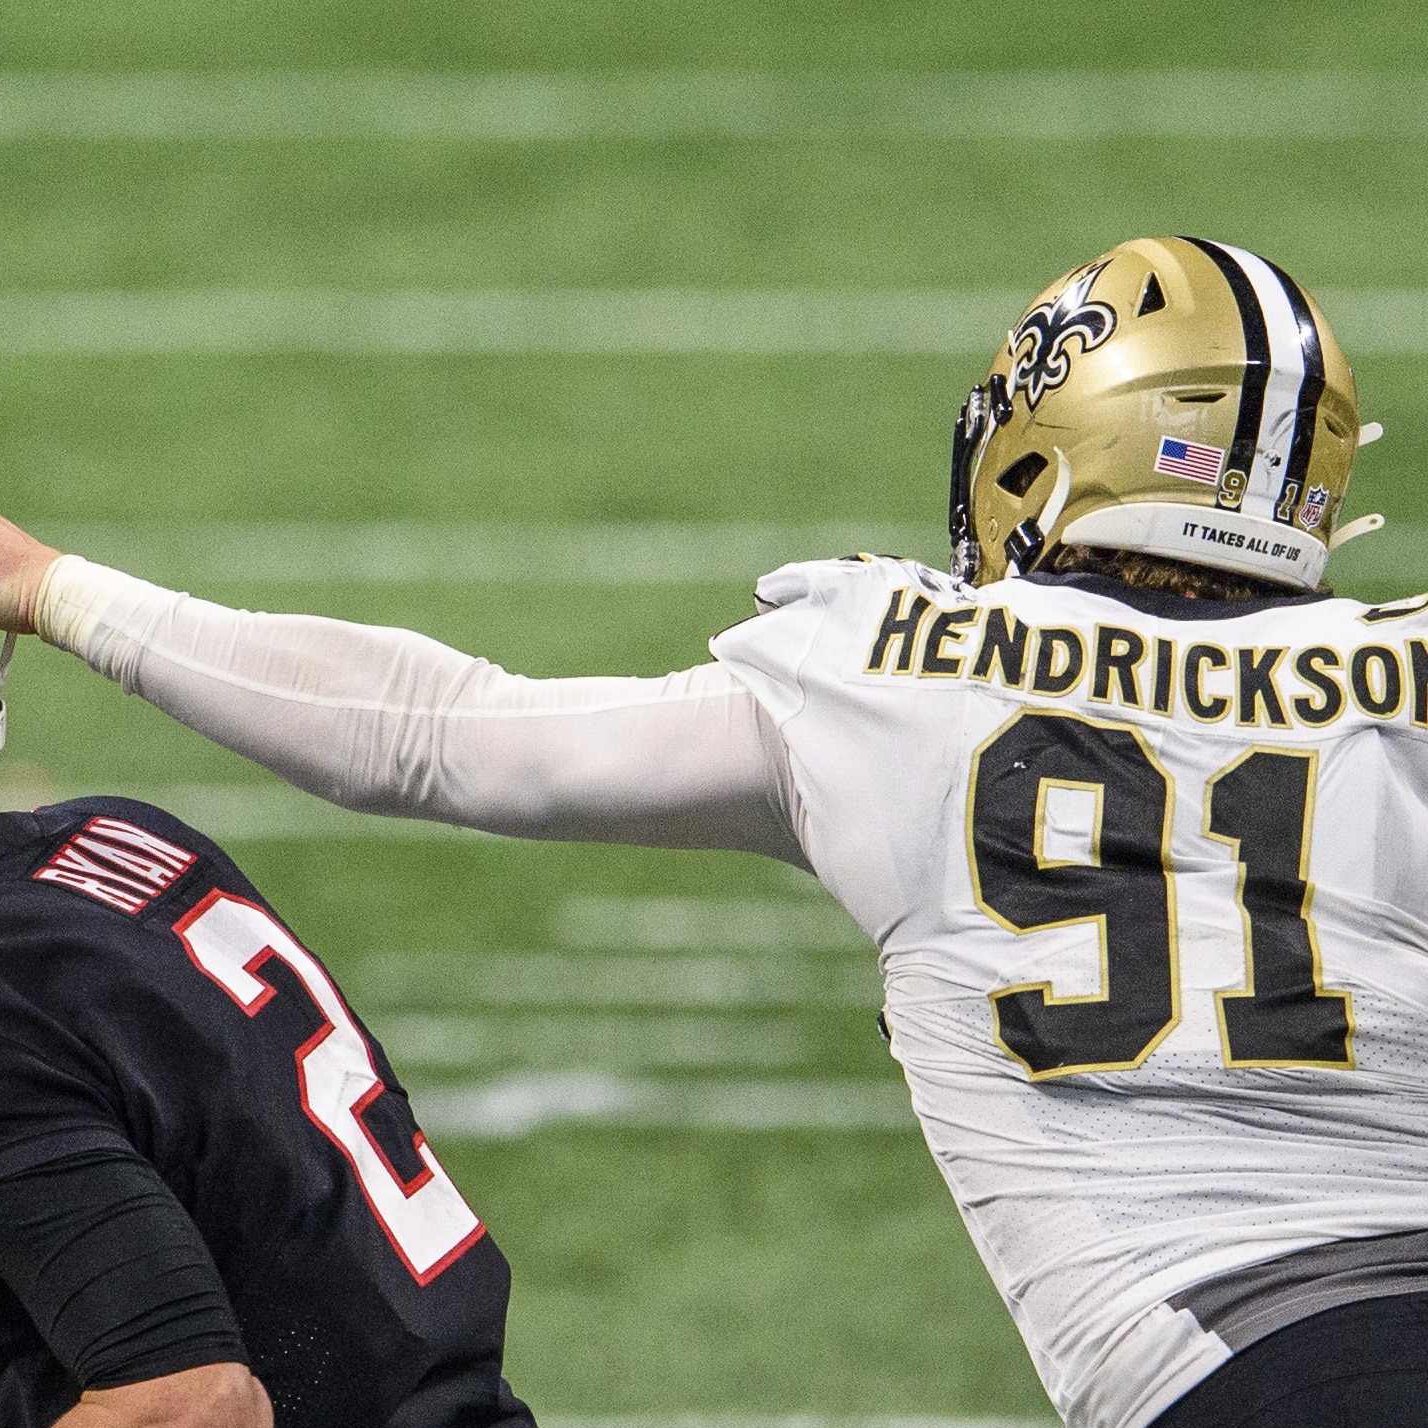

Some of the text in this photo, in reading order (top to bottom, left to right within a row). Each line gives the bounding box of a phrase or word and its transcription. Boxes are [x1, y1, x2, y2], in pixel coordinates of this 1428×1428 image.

[1183, 522, 1301, 562] IT TAKES ALL OF US
[33, 816, 197, 915] RYAN
[964, 706, 1357, 1082] 91
[172, 887, 486, 1286] 2
